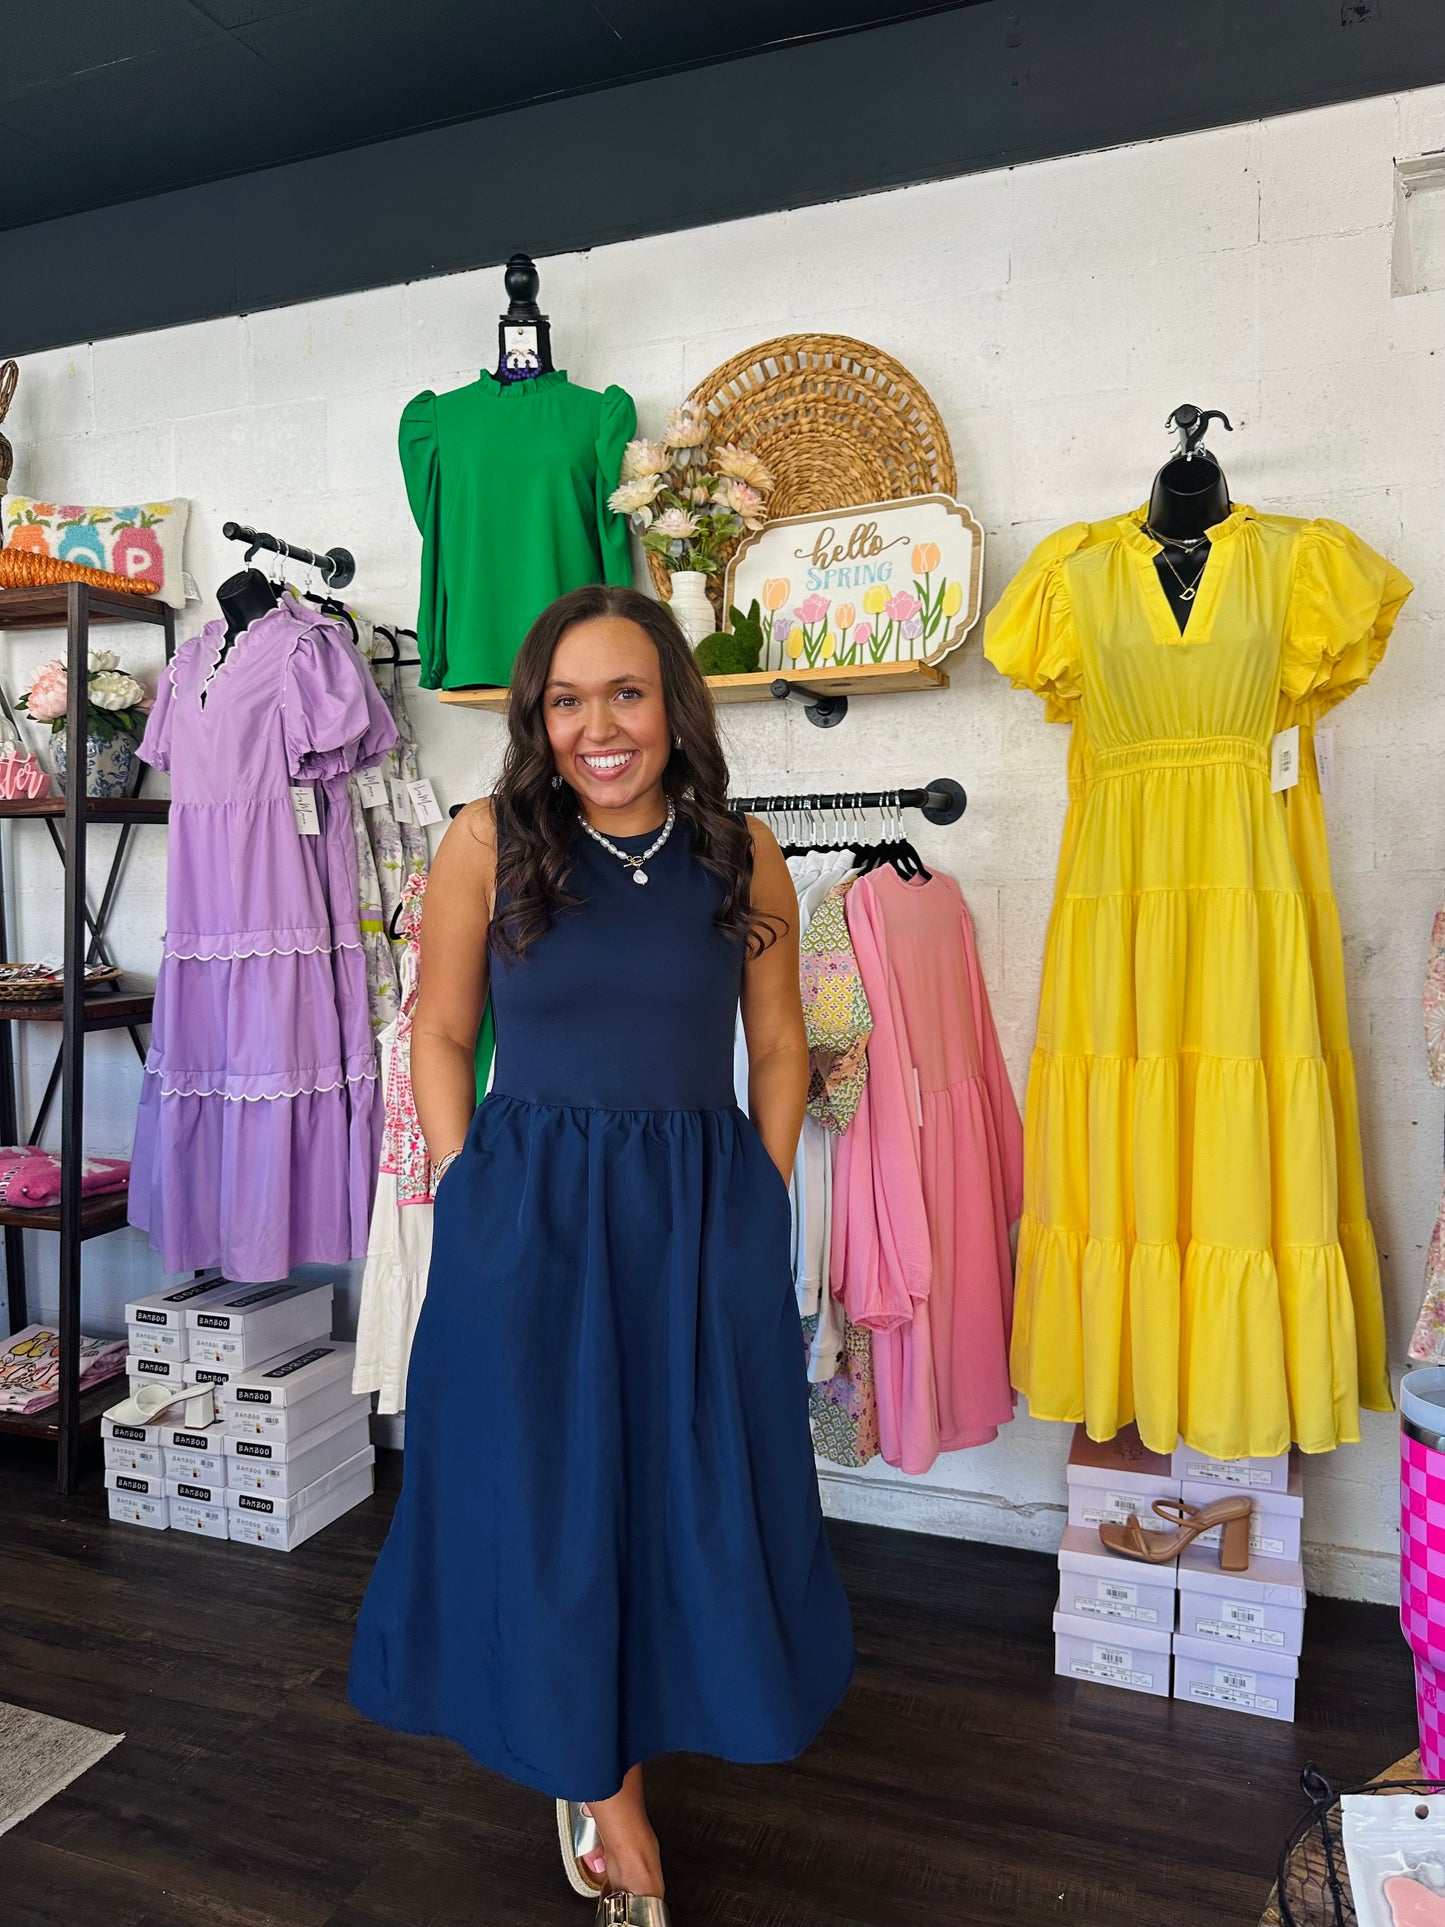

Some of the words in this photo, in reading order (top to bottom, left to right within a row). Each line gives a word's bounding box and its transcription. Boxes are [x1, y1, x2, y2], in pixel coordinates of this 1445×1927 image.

[794, 521, 911, 570] hello
[806, 561, 893, 591] SPRING
[137, 1312, 166, 1323] BAMBOO
[199, 1317, 228, 1328] BAMBOO
[139, 1363, 168, 1374] BAMBOO
[197, 1373, 227, 1383] BAMBOO
[238, 1391, 269, 1401] BAMBOO
[114, 1428, 144, 1439] BAMBOO
[174, 1435, 206, 1447] BAMBOO
[238, 1445, 270, 1456] BAMBOO
[118, 1479, 147, 1491] BAMBOO
[179, 1486, 209, 1499] BAMBOO
[240, 1498, 272, 1511] BAMBOO
